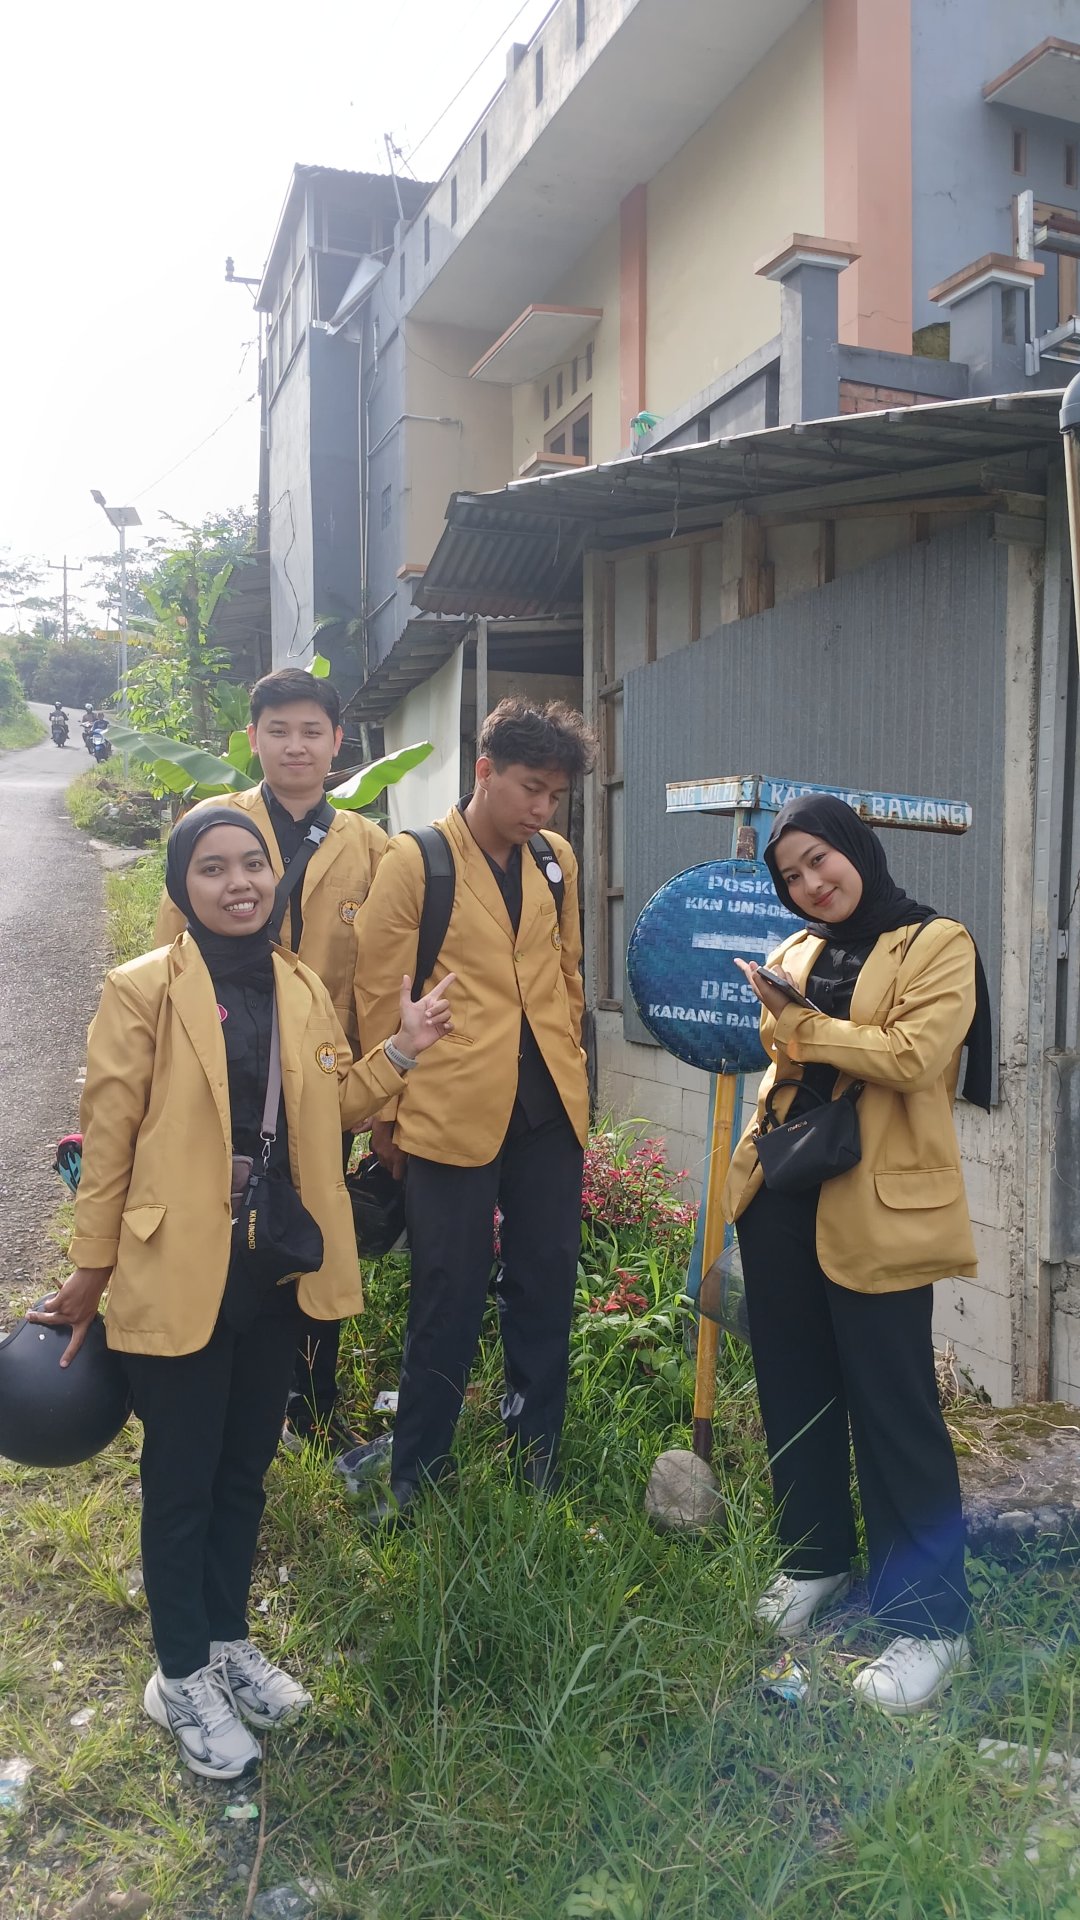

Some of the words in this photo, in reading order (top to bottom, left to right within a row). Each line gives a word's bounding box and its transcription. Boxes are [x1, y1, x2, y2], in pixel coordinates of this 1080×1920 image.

[685, 896, 723, 911] KKN
[700, 980, 761, 1004] DES
[648, 1003, 723, 1025] KARANG
[248, 1223, 256, 1250] UNSOED
